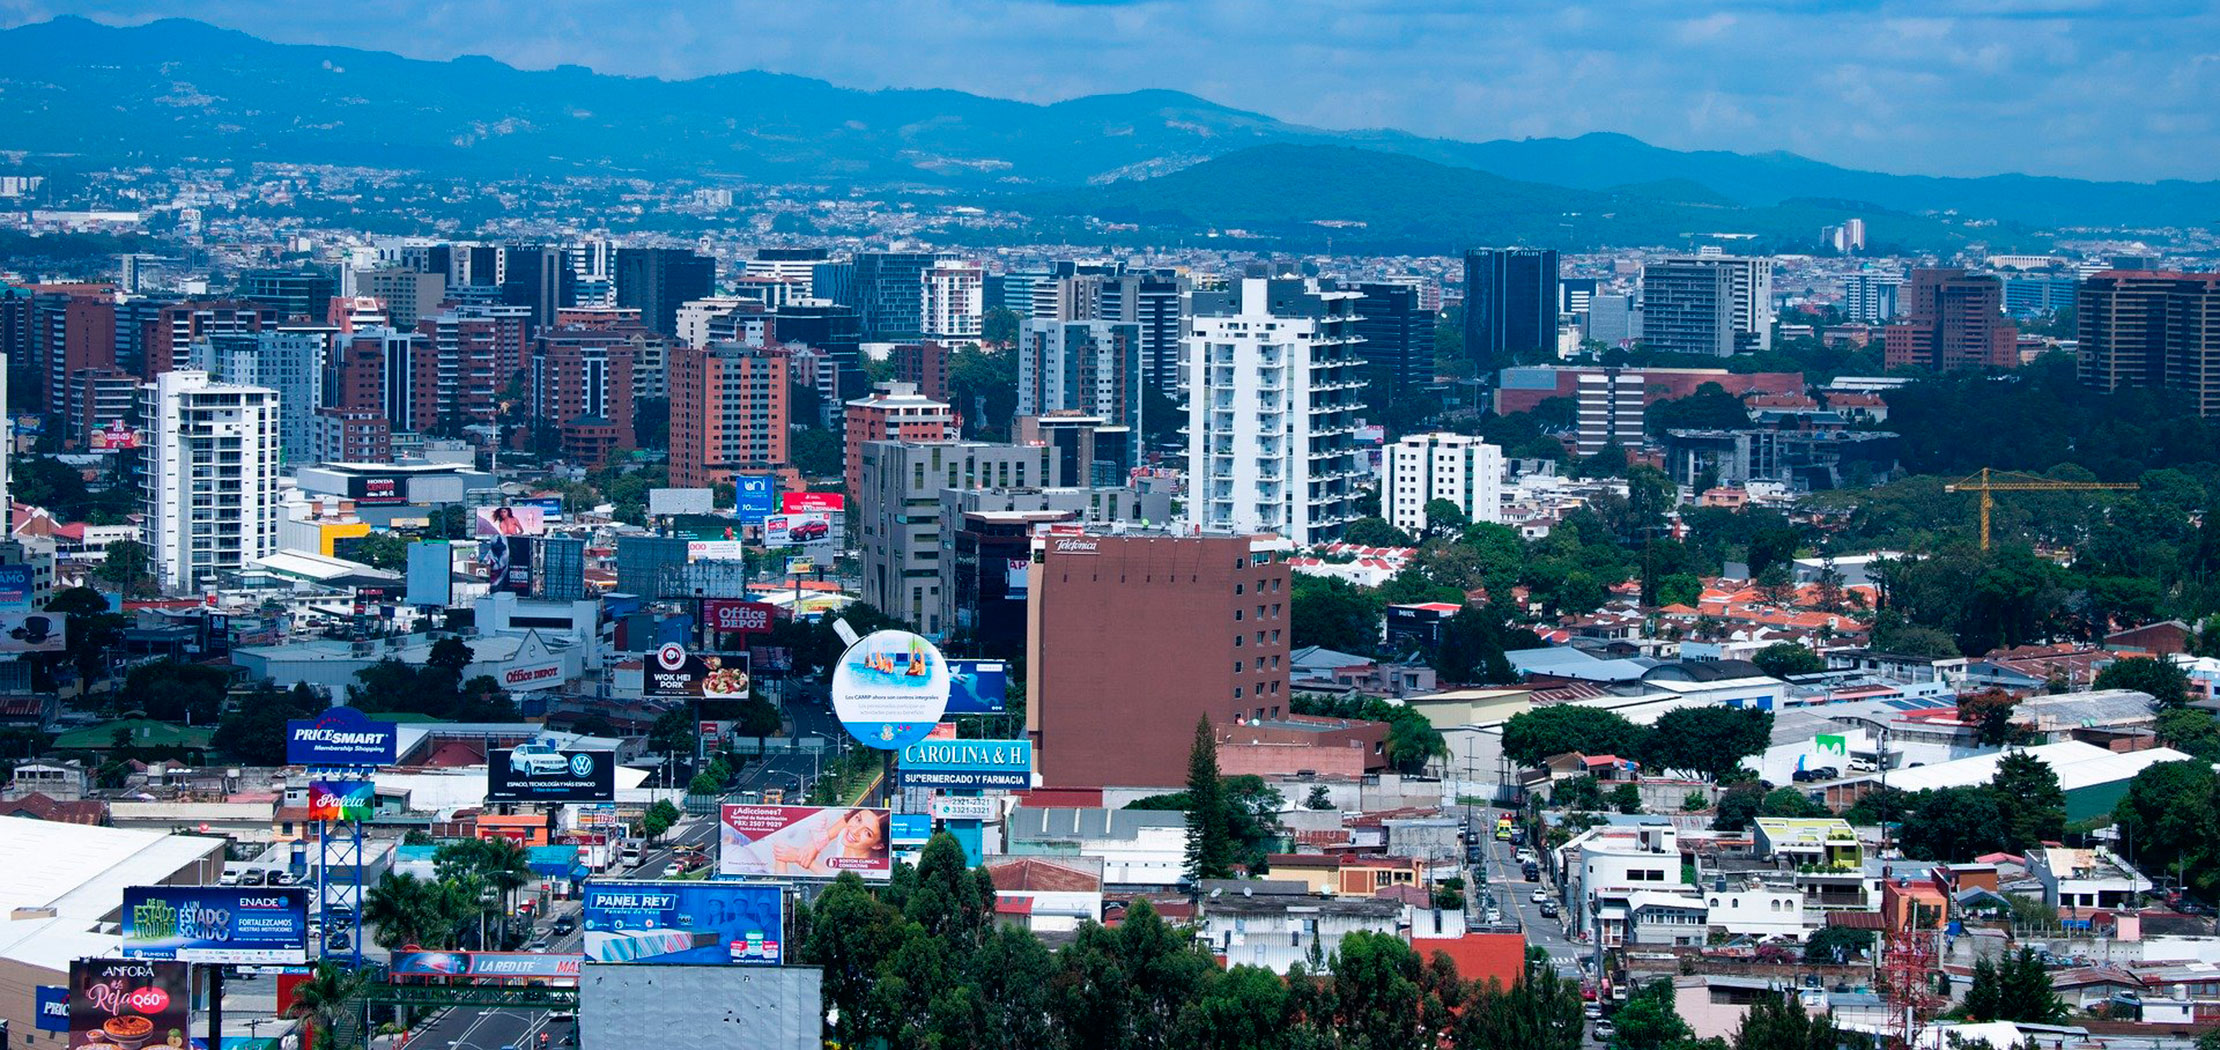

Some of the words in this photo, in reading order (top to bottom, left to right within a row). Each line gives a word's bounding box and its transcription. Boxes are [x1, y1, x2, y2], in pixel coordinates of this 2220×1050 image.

[719, 606, 768, 620] Office
[720, 619, 767, 629] DEPOT
[506, 669, 533, 684] Office
[534, 667, 558, 679] DEPOT
[654, 674, 676, 682] WOK
[677, 674, 691, 682] HEI
[660, 681, 684, 689] PORK
[294, 729, 384, 744] PRICESMART
[355, 745, 385, 753] Shopping
[905, 745, 989, 764] CAROLINA
[993, 746, 1005, 764] &
[1010, 747, 1025, 764] H.
[905, 774, 973, 784] SUPERMERCADO
[974, 775, 981, 783] Y
[982, 775, 1025, 784] FARMACIA
[316, 794, 365, 807] Paleta
[952, 806, 990, 814] 3321-3321
[240, 898, 278, 907] ENADE
[597, 896, 639, 907] PANEL
[642, 896, 670, 907] REY
[134, 905, 177, 922] ESTADO
[180, 909, 230, 925] ESTADO
[102, 966, 155, 977] ANFORA
[479, 961, 494, 972] LA
[494, 961, 516, 972] RED
[516, 961, 535, 972] LTE
[132, 993, 160, 1009] Q60
